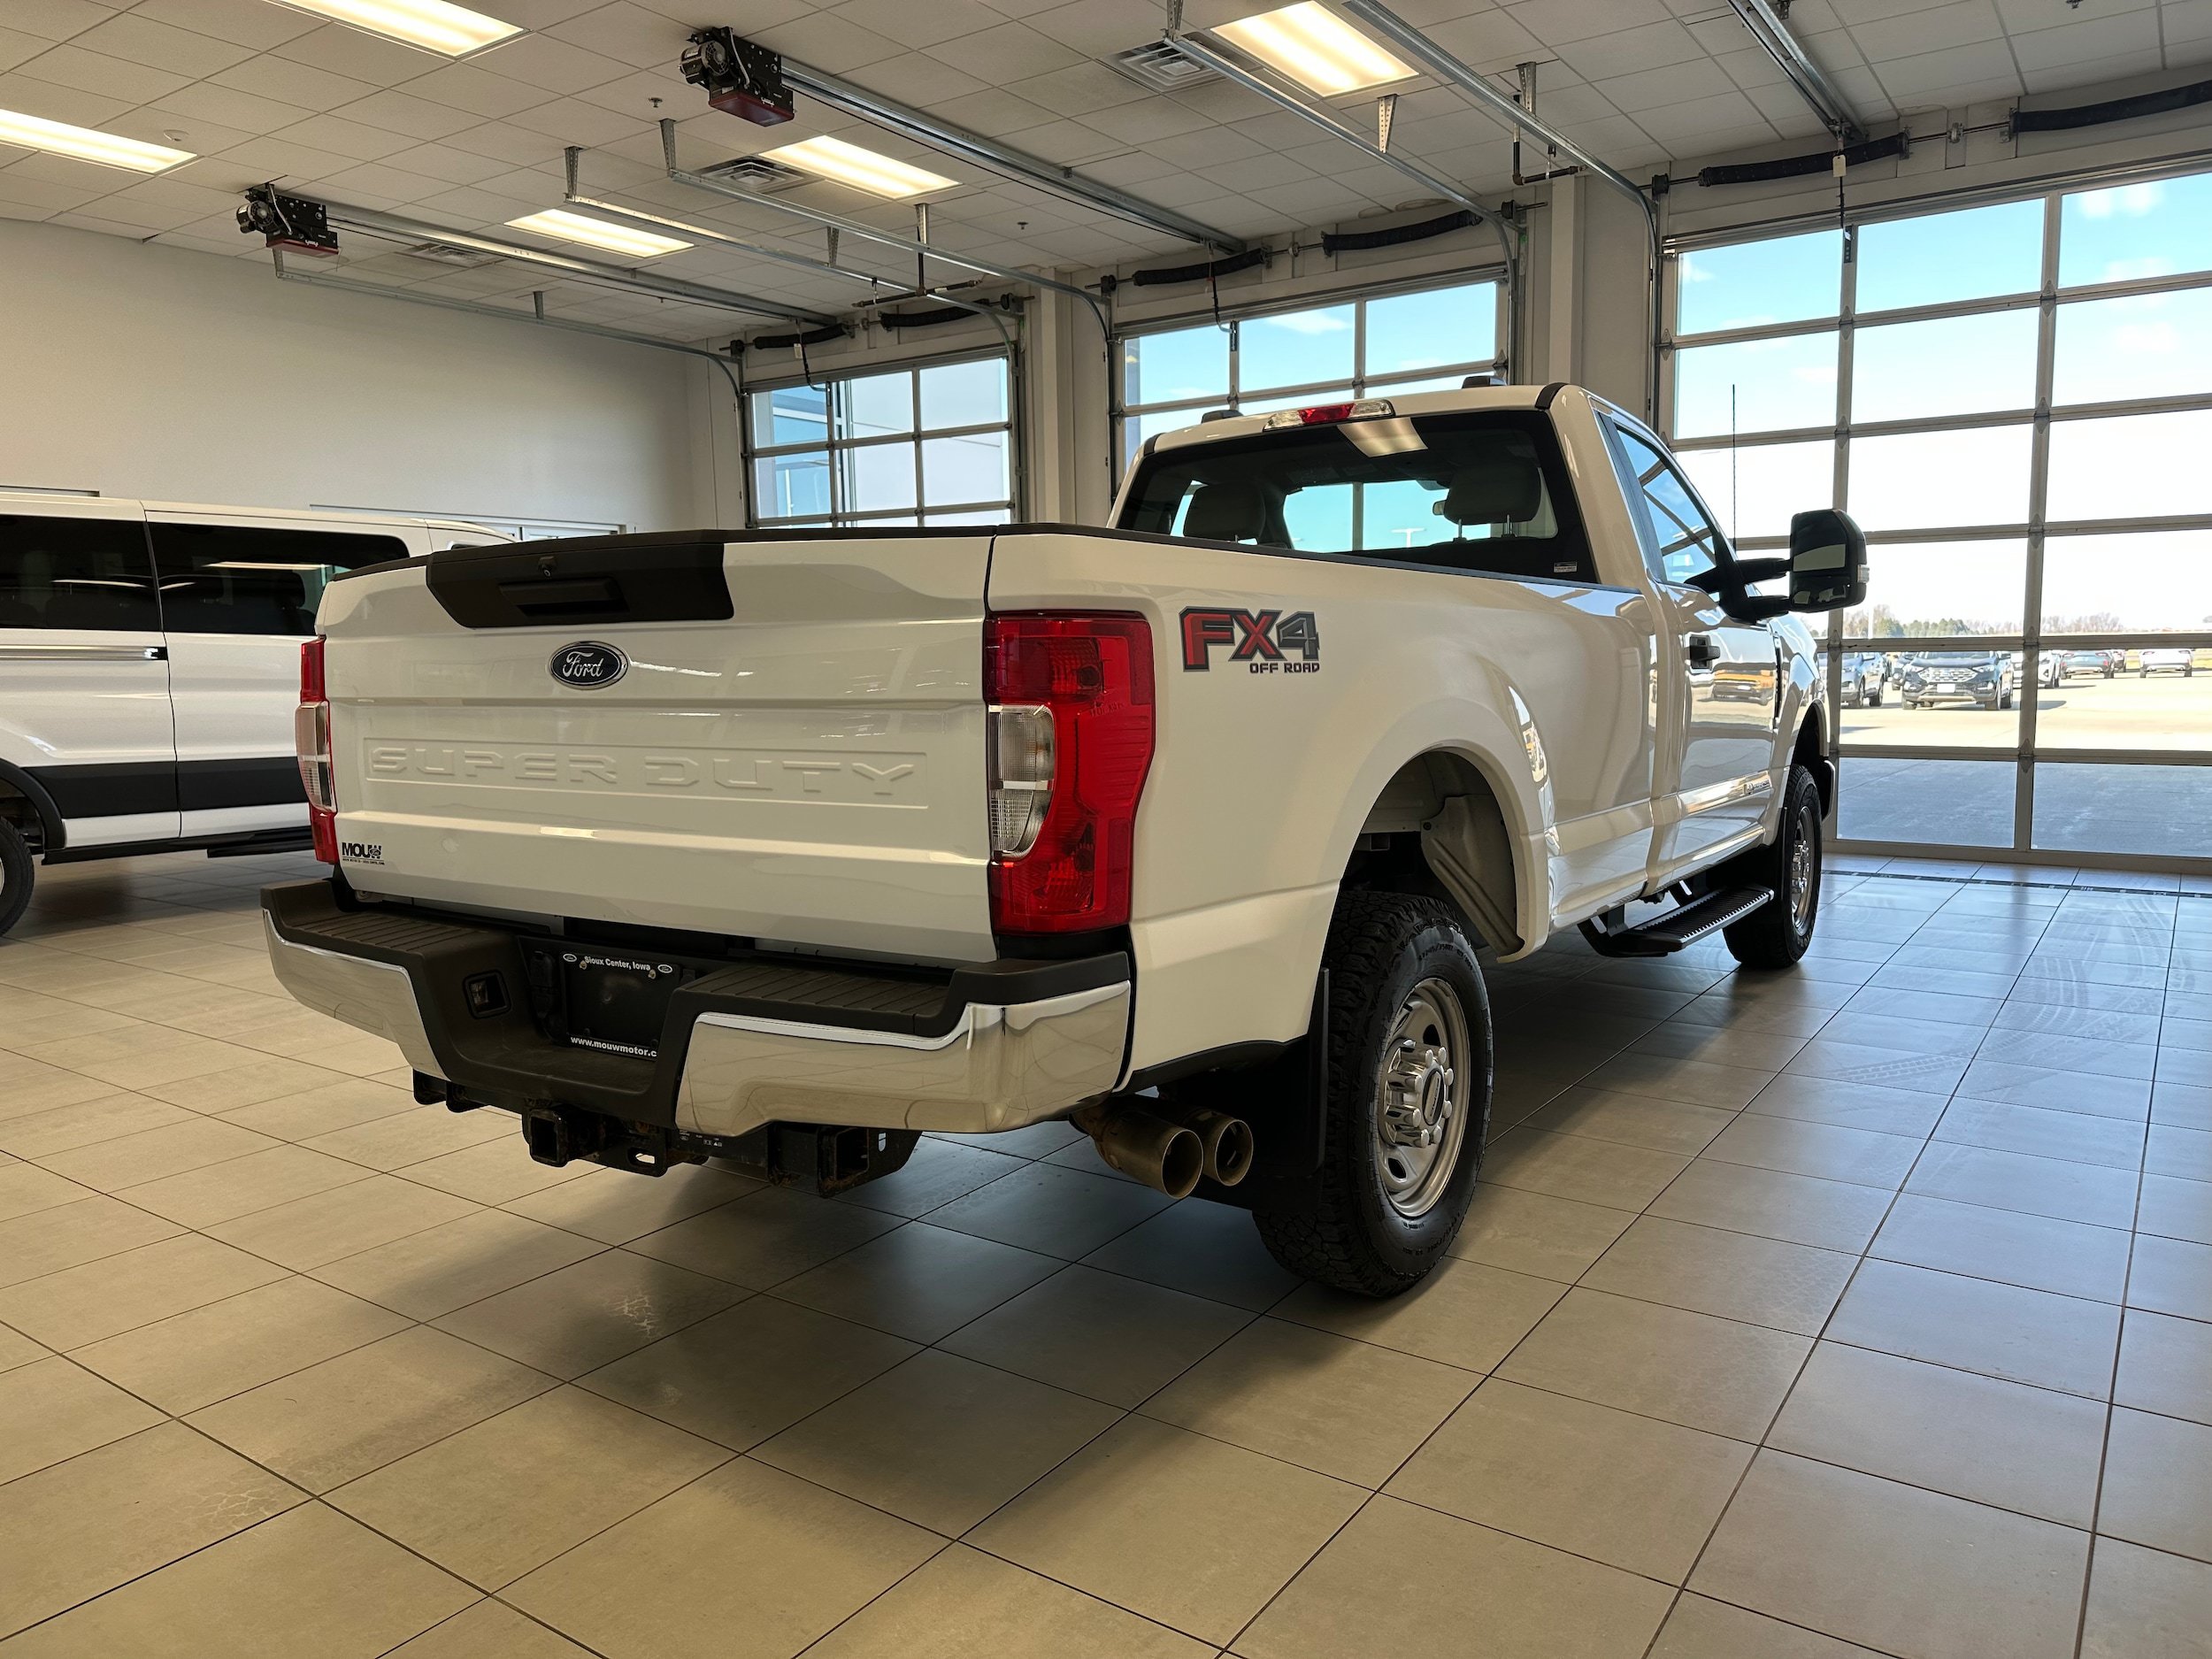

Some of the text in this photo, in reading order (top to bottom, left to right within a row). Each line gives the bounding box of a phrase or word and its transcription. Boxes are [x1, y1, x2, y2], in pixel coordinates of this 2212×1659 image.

[1179, 606, 1320, 672] FX4
[562, 651, 604, 677] Ford
[1249, 663, 1320, 674] OFF ROAD
[372, 747, 915, 795] SUPER DUTY
[584, 956, 605, 966] Sioux
[605, 958, 632, 970] Center,
[633, 961, 651, 971] Iowa
[571, 1036, 657, 1057] www.mouwmotor.c
